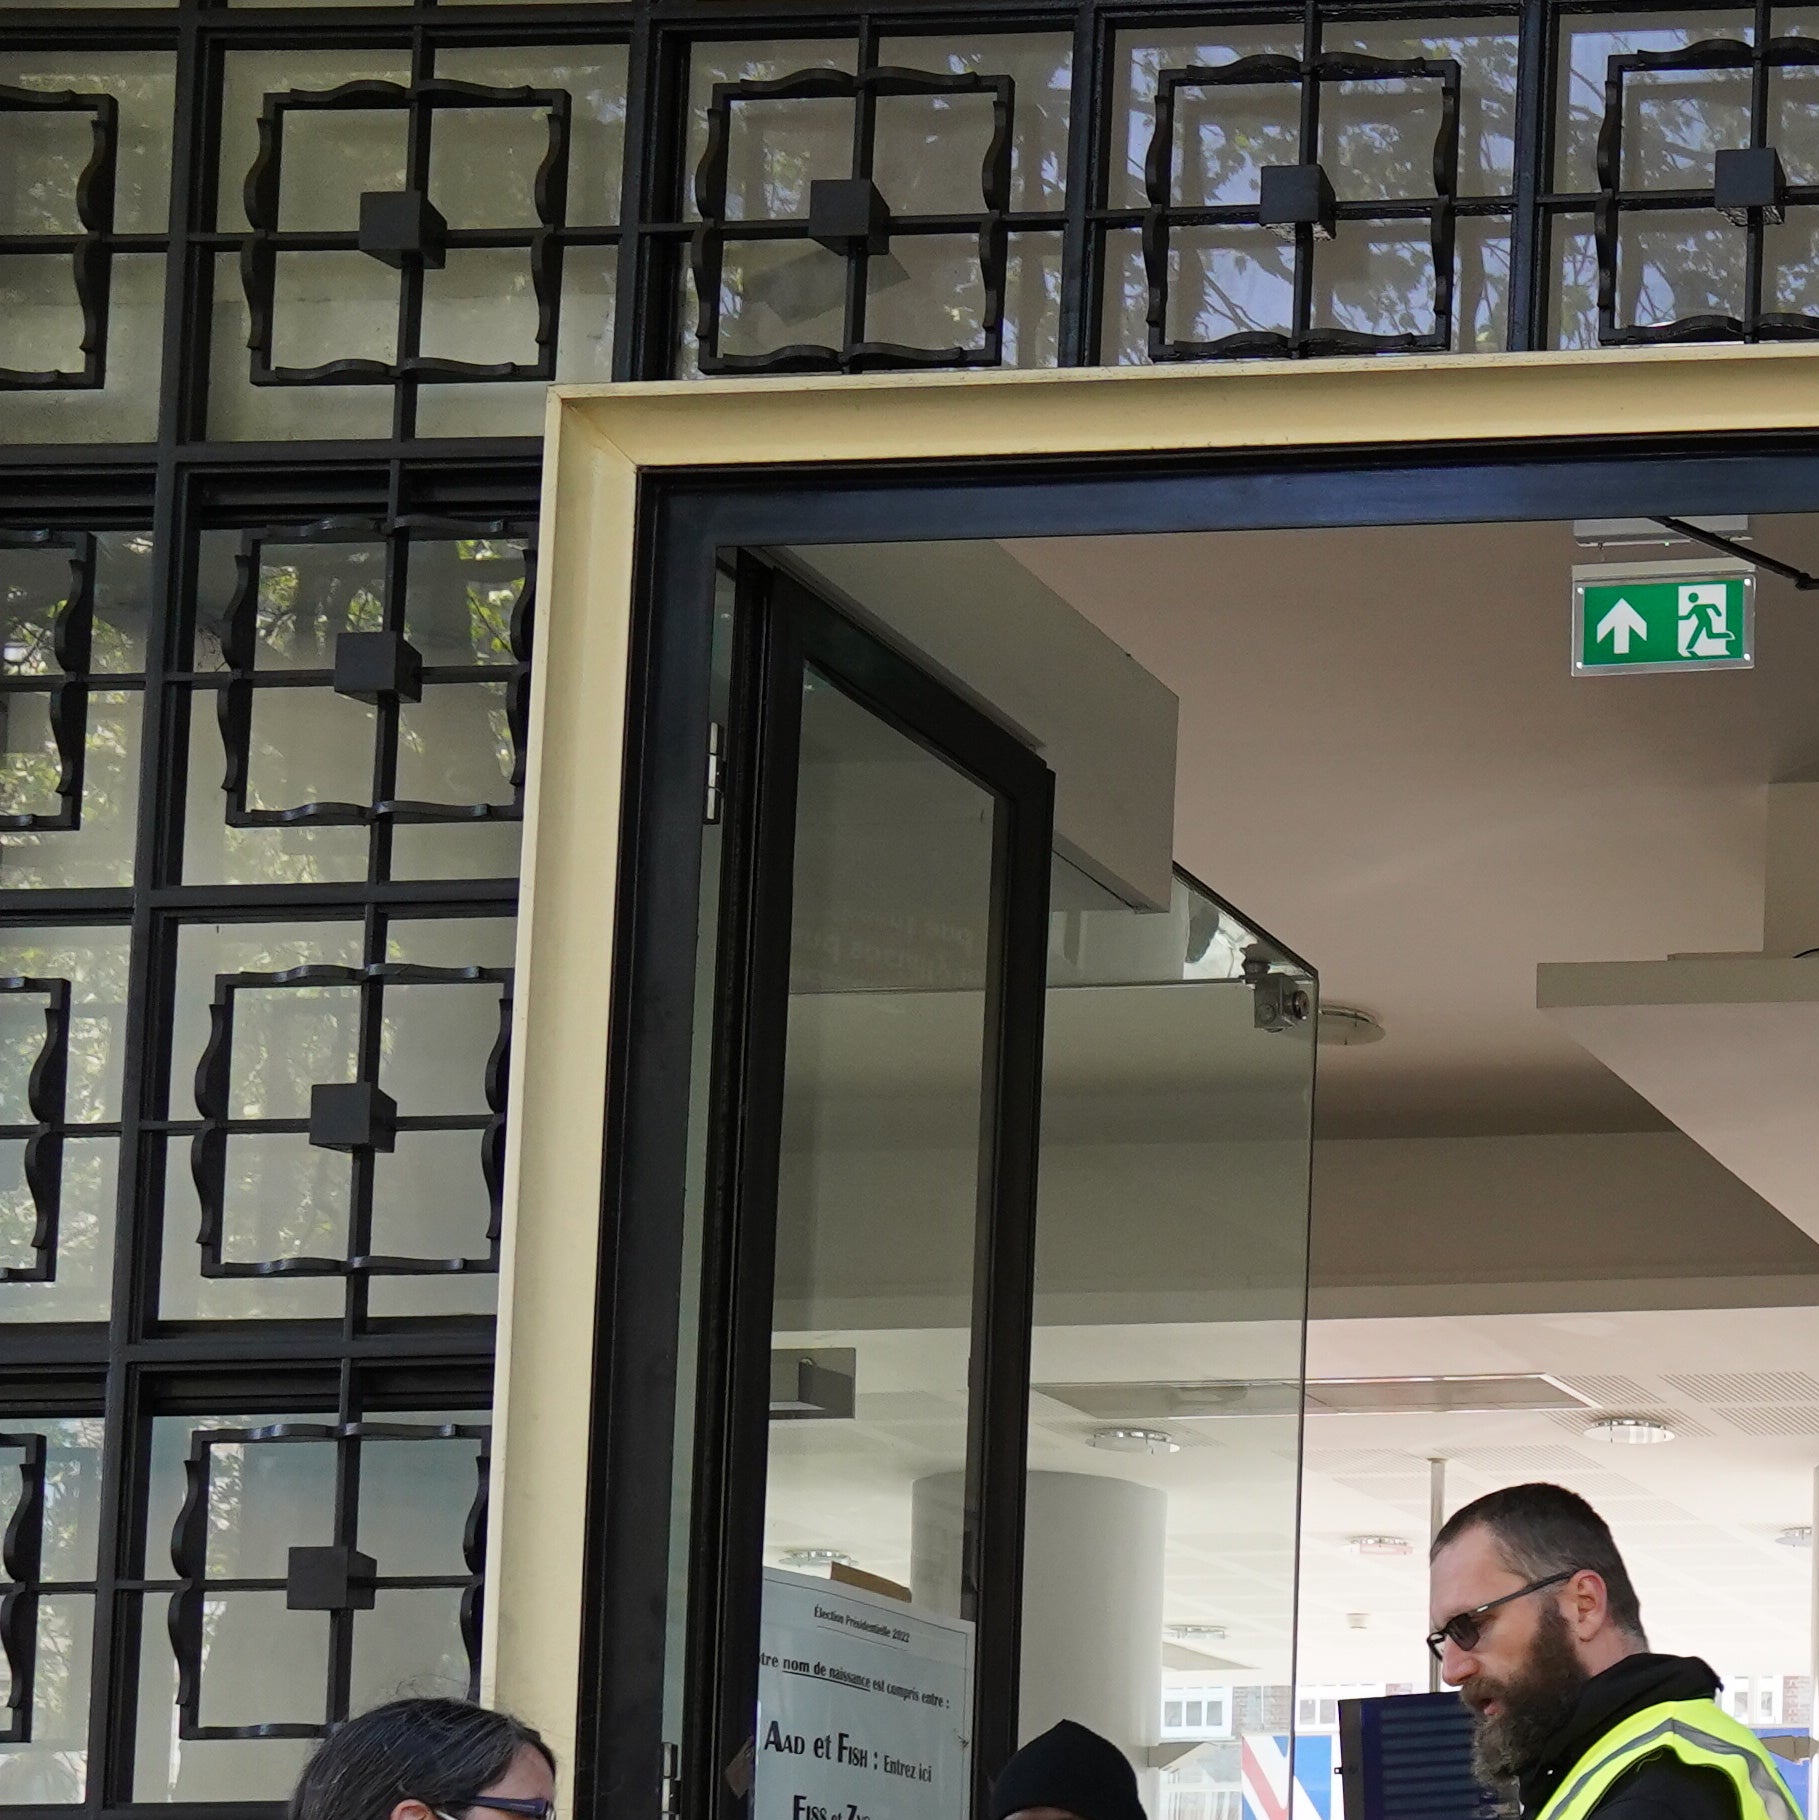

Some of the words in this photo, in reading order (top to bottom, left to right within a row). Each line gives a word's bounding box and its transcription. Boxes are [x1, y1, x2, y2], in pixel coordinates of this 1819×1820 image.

[758, 1653, 779, 1668] tre
[782, 1659, 810, 1673] nom
[813, 1661, 827, 1676] de
[829, 1666, 871, 1688] naissance
[872, 1678, 886, 1692] est
[886, 1684, 920, 1703] compris
[921, 1692, 944, 1708] entre
[813, 1734, 832, 1761] et
[883, 1755, 916, 1781] Entrez
[918, 1763, 933, 1783] ici
